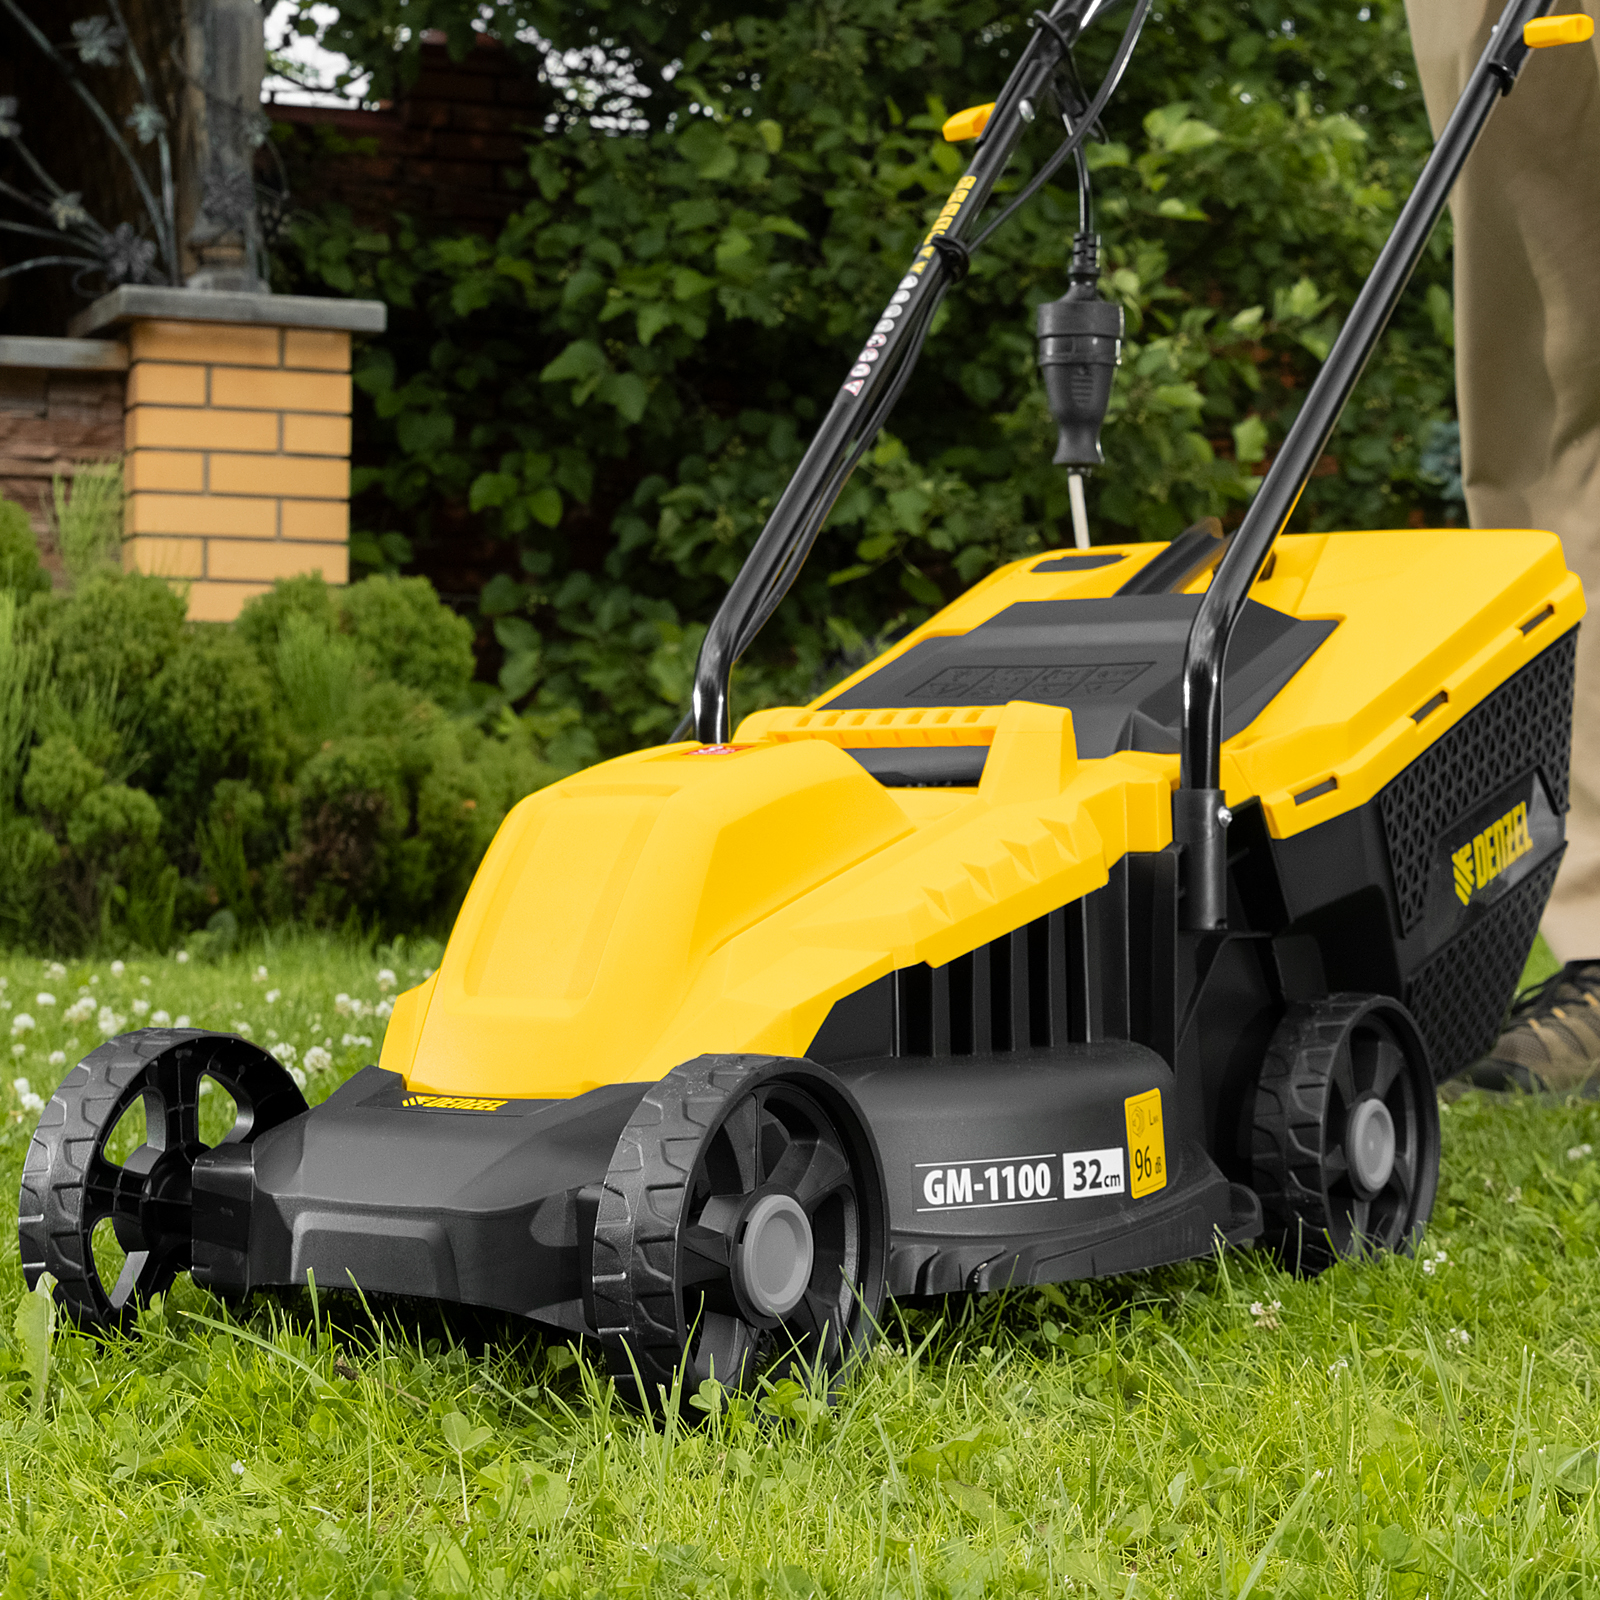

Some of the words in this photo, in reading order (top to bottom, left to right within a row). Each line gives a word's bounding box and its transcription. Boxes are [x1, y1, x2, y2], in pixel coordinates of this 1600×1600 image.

[1472, 801, 1533, 890] DENZEL
[923, 1162, 1051, 1205] GM-1100
[1135, 1145, 1152, 1181] 96
